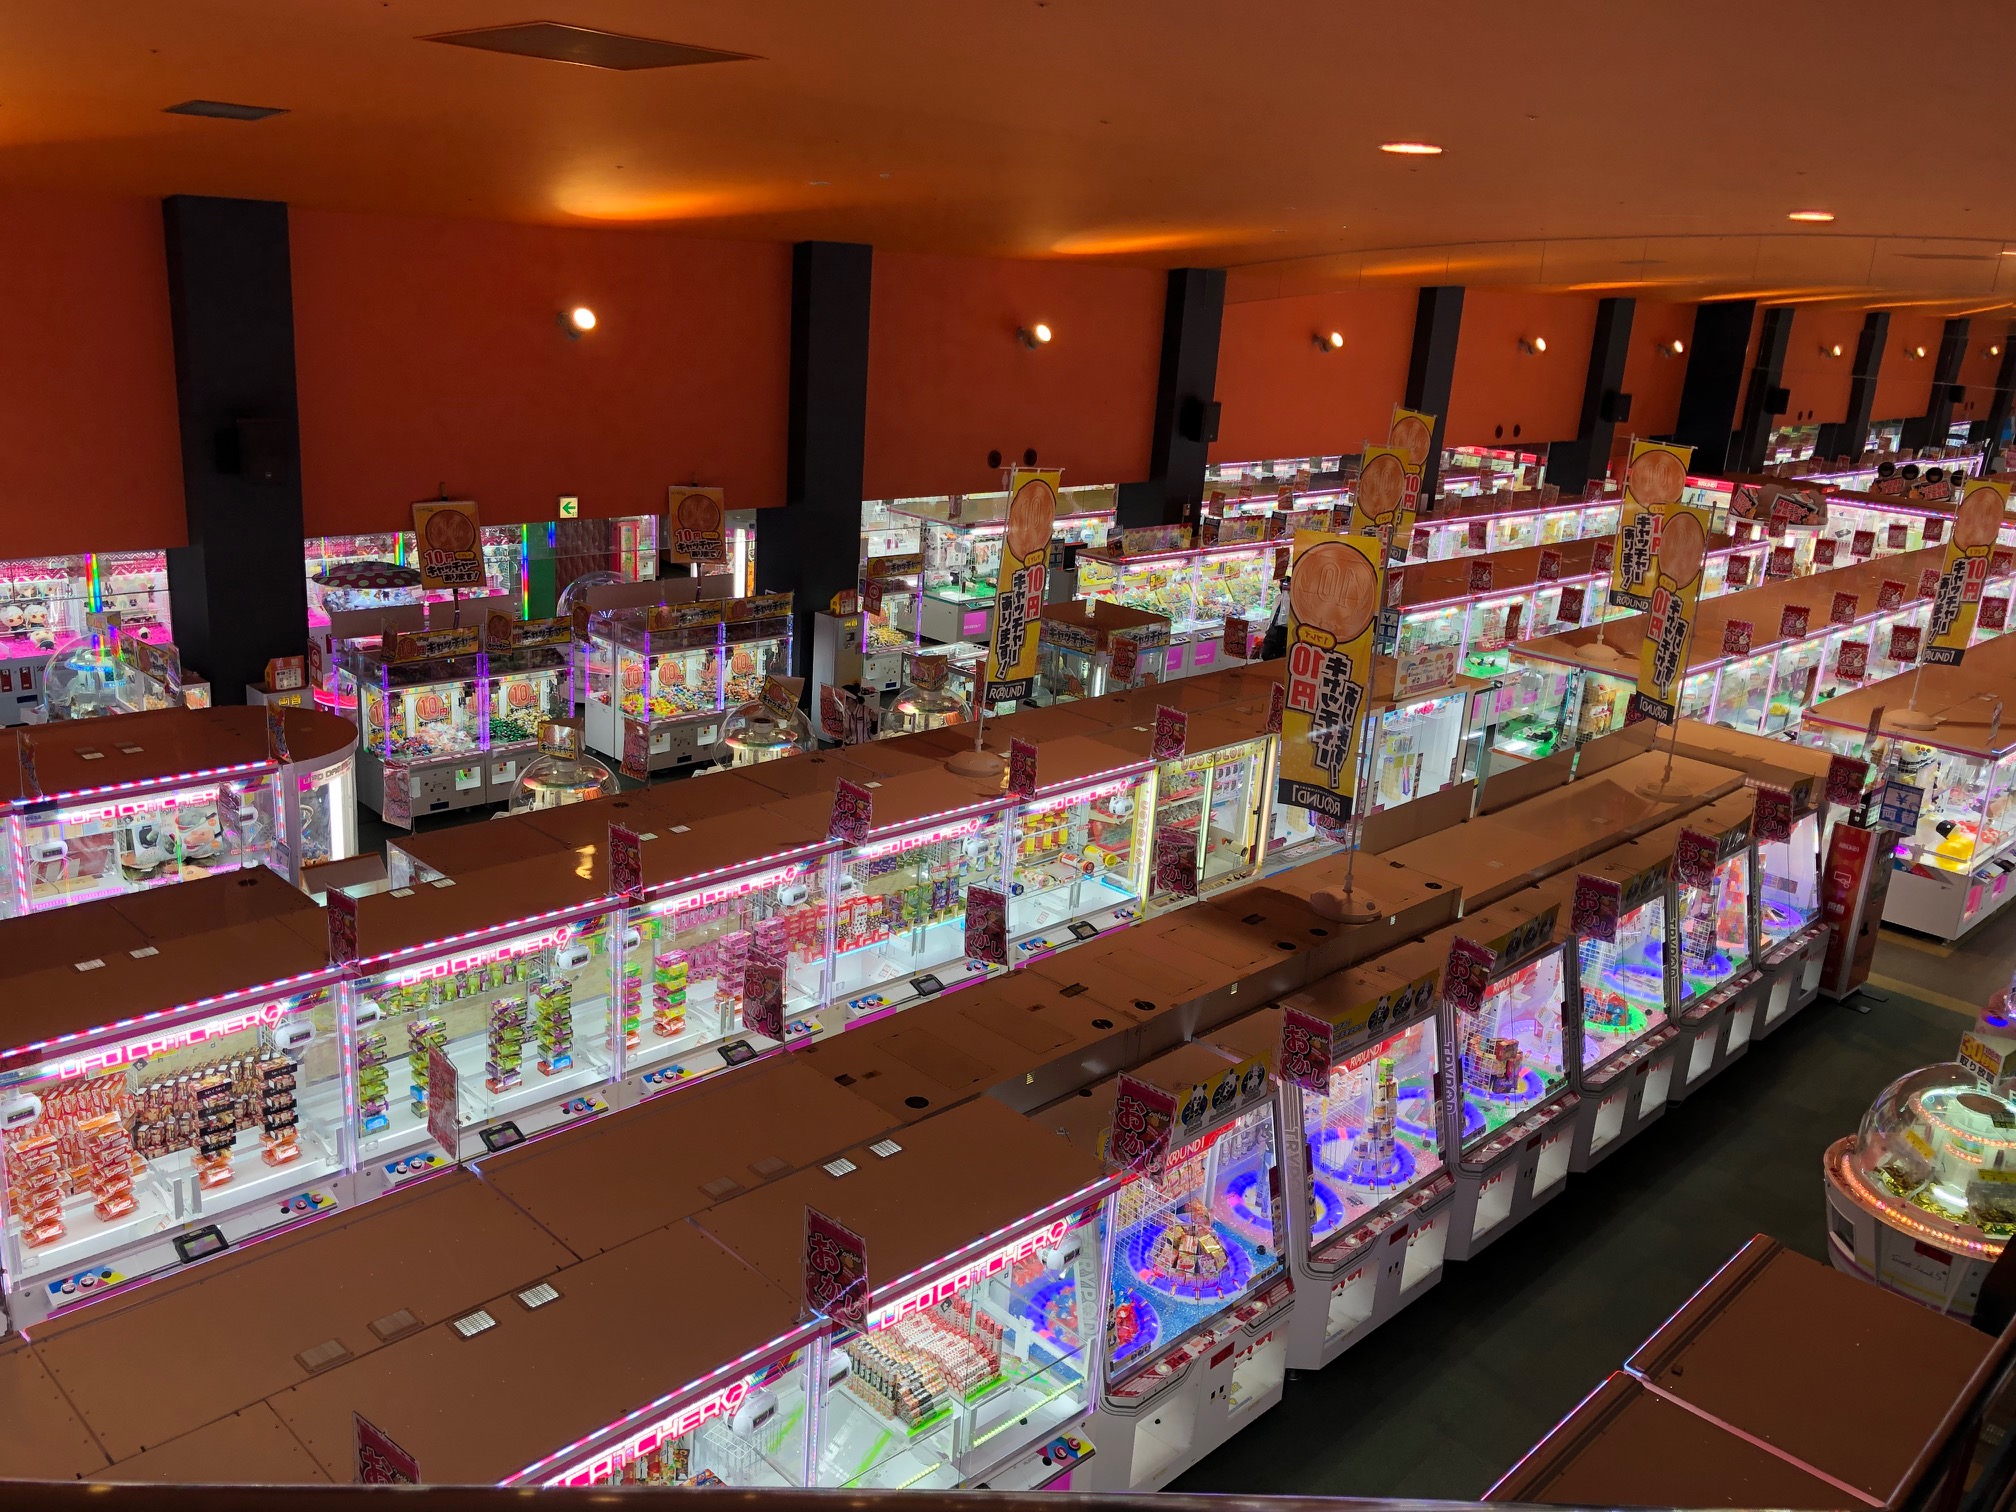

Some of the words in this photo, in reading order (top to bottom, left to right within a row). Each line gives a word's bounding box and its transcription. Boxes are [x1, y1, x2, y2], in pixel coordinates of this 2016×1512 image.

[676, 529, 701, 543] 10円
[677, 539, 722, 553] キャッチャー
[1634, 514, 1651, 583] キャッチャー
[425, 550, 454, 566] 10円
[426, 560, 479, 577] キャッチャー
[1026, 565, 1044, 620] 10円
[1963, 558, 1987, 602] 10円
[1011, 571, 1028, 668] キャッチャー
[1180, 755, 1203, 771] UFO
[70, 804, 116, 826] UFO
[1038, 799, 1065, 814] UFO
[1756, 798, 1789, 839] おかし
[1881, 806, 1917, 827] 両替
[869, 842, 900, 860] UFO
[1677, 838, 1711, 887] おかし
[662, 893, 700, 917] UFO
[1576, 887, 1613, 936] おかし
[400, 957, 449, 988] UFO
[1450, 951, 1479, 1011] おかし
[745, 967, 780, 1034] おかし
[58, 1046, 123, 1080] UFO
[1284, 1023, 1326, 1088] おかし
[1959, 1054, 1996, 1085] 取り放題
[1116, 1096, 1161, 1173] おかし
[809, 1232, 863, 1323] おかし
[879, 1289, 934, 1332] UFO
